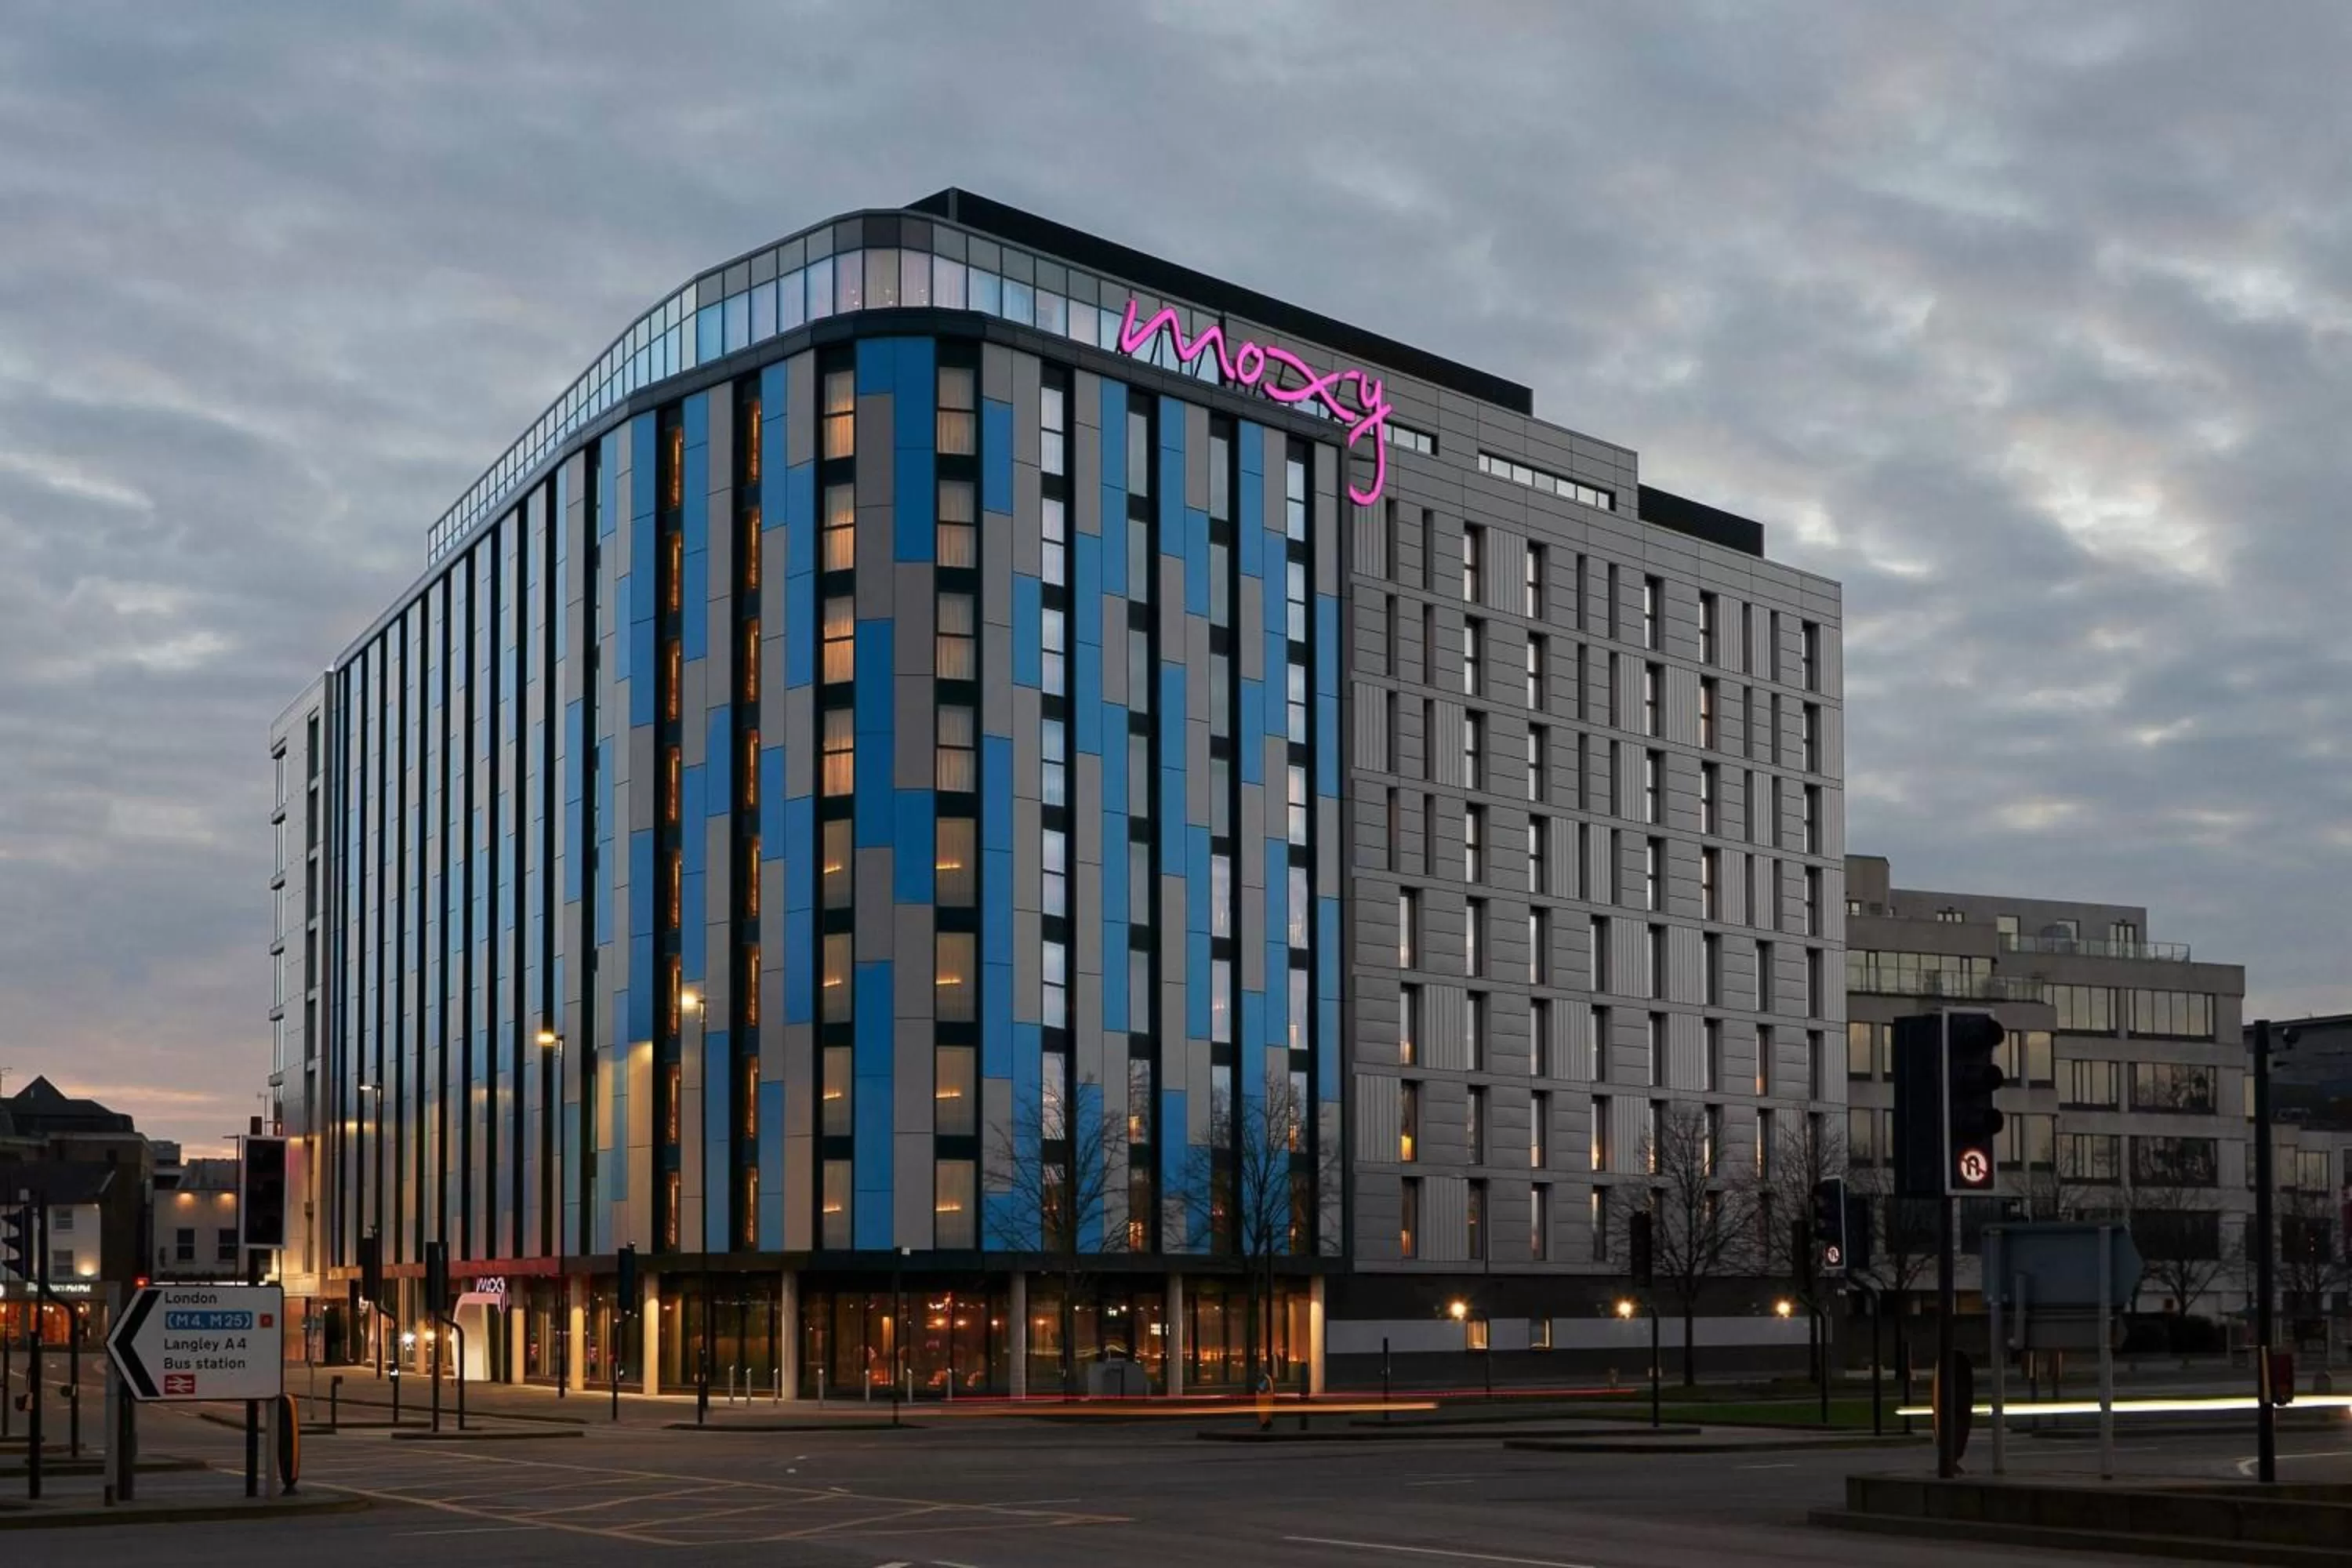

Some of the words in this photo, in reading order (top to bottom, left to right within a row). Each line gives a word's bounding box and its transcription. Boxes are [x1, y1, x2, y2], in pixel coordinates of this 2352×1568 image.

[165, 1292, 217, 1304] London
[209, 1314, 251, 1327] M25)
[164, 1338, 220, 1352] Langley
[225, 1338, 247, 1350] A4
[164, 1357, 191, 1369] Bus
[196, 1357, 245, 1369] station
